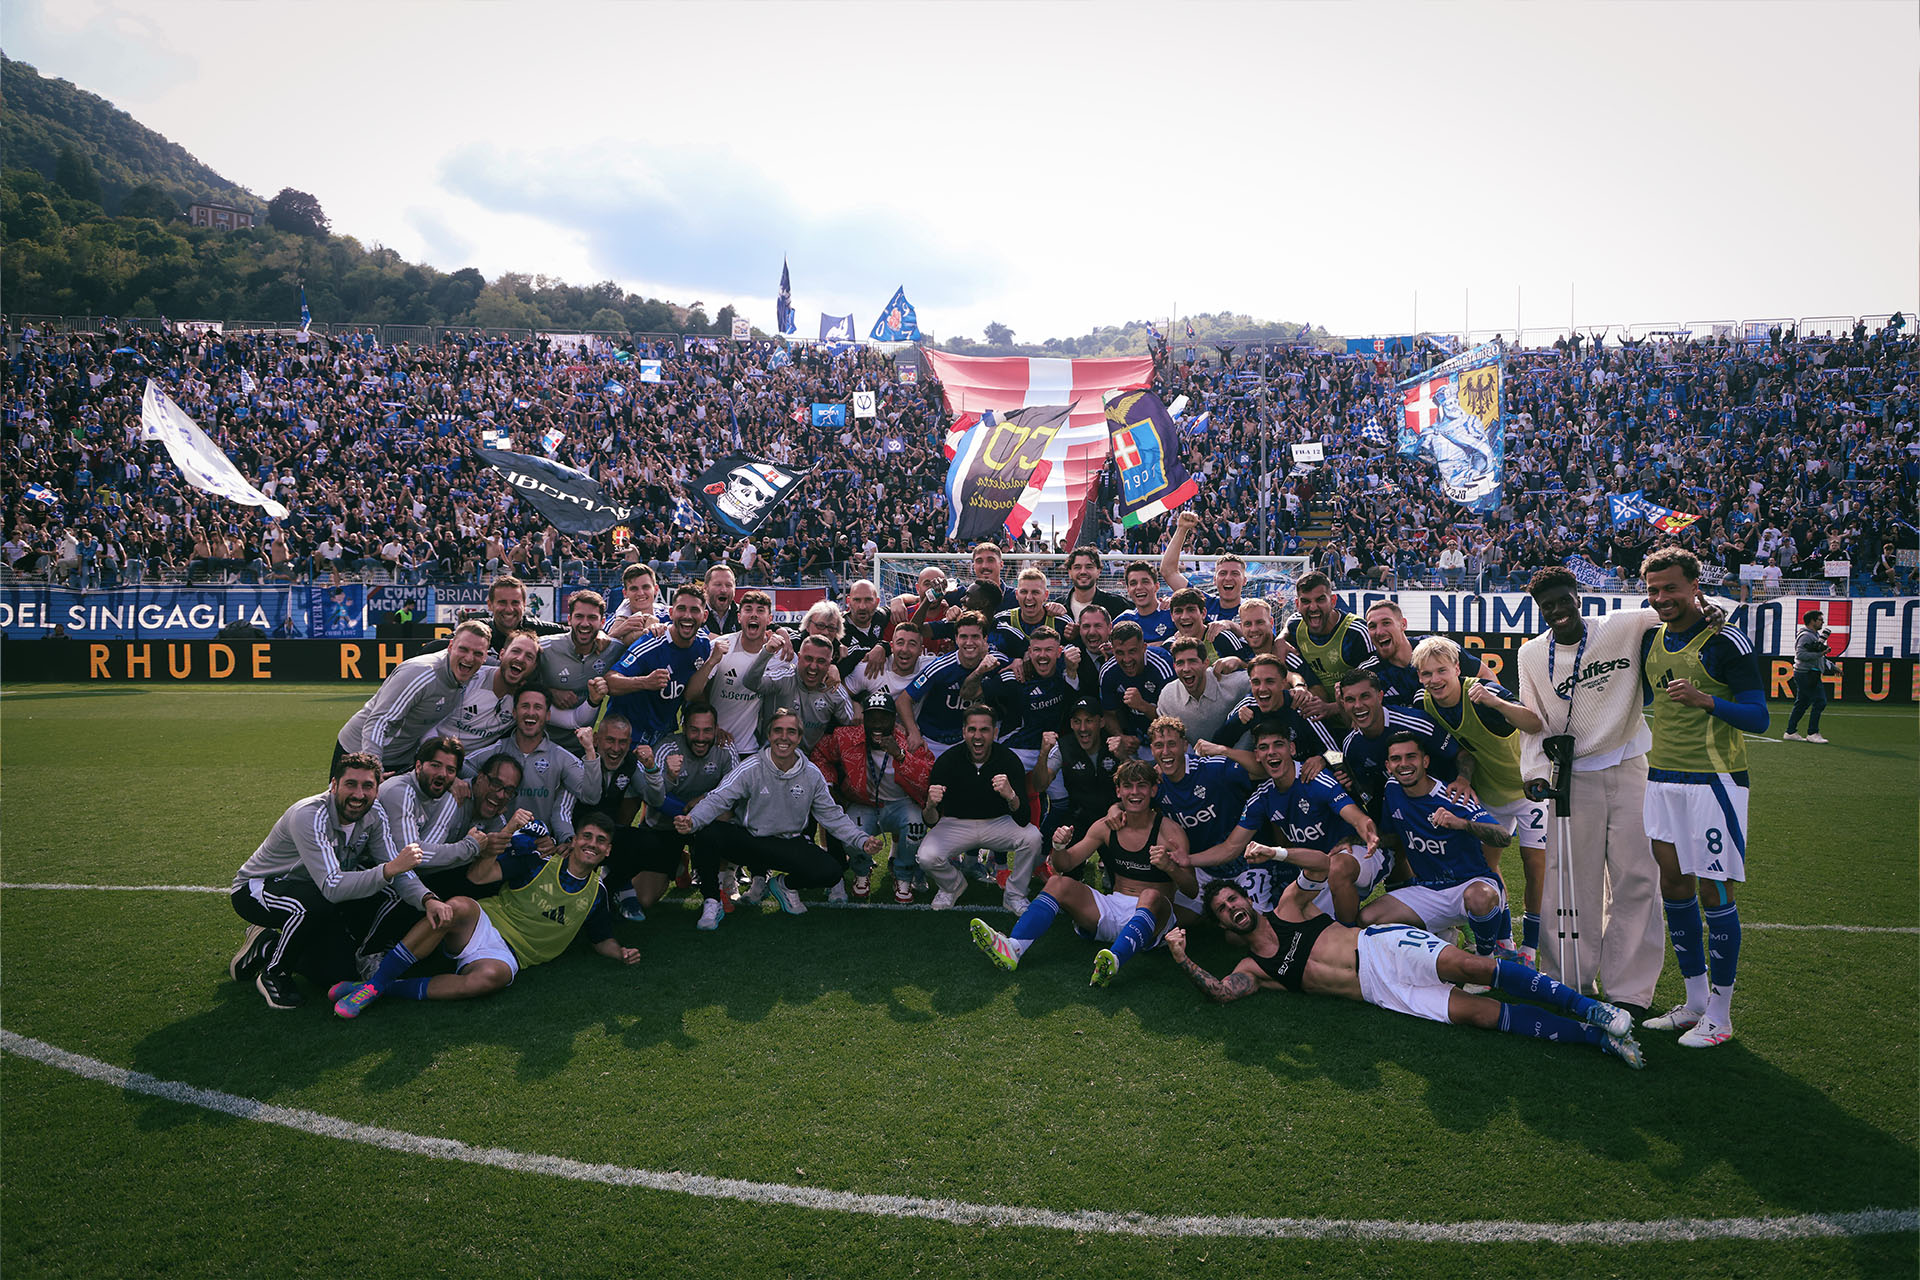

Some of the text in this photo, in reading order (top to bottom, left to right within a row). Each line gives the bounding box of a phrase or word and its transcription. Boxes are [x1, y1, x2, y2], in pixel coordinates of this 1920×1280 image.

[67, 603, 271, 630] SINIGAGLIA
[311, 588, 323, 637] VETERANI
[369, 599, 426, 611] MCMII
[90, 643, 272, 679] RHUDE
[1280, 822, 1326, 843] Uber
[1705, 827, 1723, 855] 8
[1243, 872, 1267, 894] 31
[1397, 929, 1430, 948] 10
